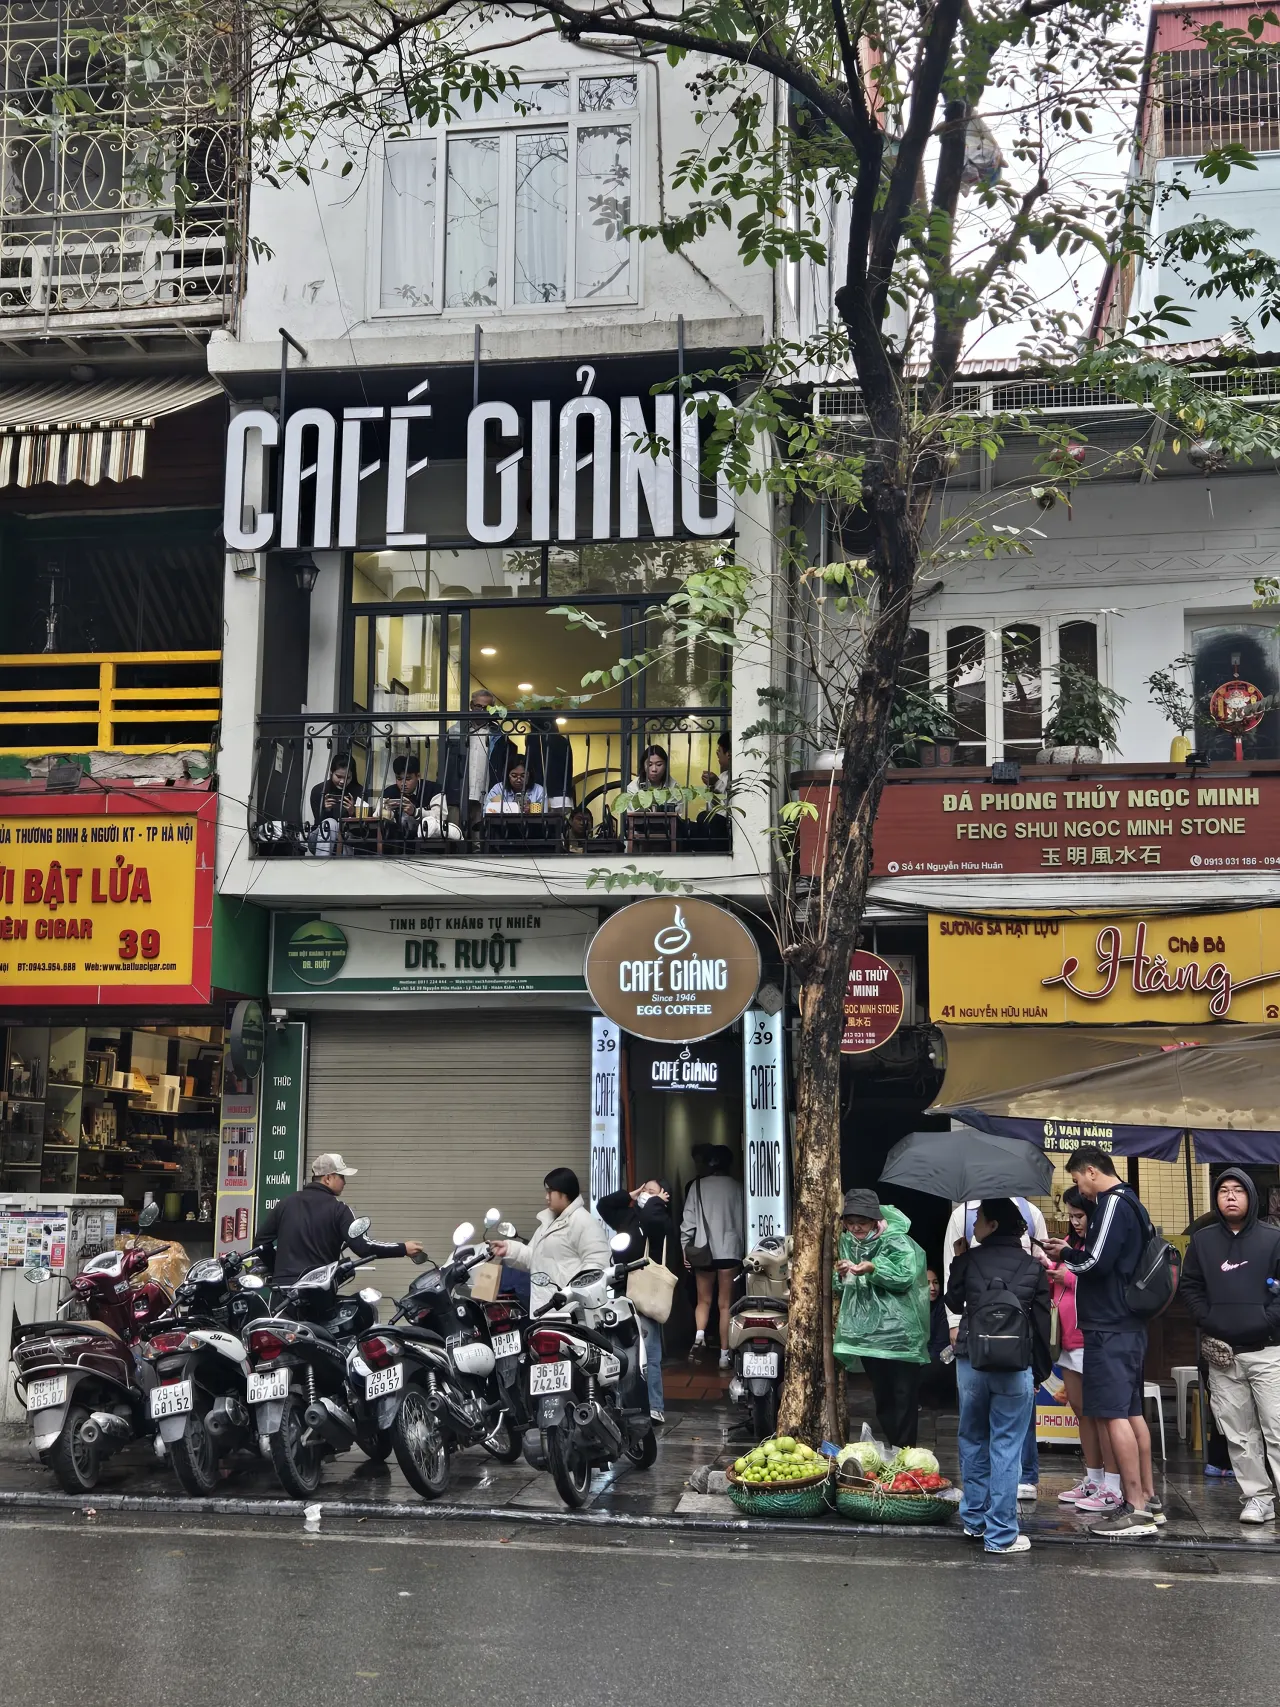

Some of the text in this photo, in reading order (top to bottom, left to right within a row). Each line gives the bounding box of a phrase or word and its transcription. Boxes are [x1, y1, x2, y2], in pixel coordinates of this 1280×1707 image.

[223, 379, 432, 552] CAFÉ
[942, 784, 1260, 812] ĐÁ PHONG THỦY NGỌC MINH
[16, 826, 52, 844] THƯƠNG
[56, 827, 78, 844] BINH
[81, 828, 88, 843] &
[91, 823, 119, 843] NGƯỜI
[123, 826, 135, 842] KT
[147, 826, 158, 842] TP
[162, 823, 174, 842] HÀ
[178, 822, 193, 845] NỘI
[956, 817, 1246, 840] FENG SHUI NGOC MINH STONE
[1041, 845, 1161, 866] 玉明風水石
[1204, 857, 1223, 866] 0913
[1225, 857, 1239, 865] 031
[1242, 857, 1257, 865] 186
[915, 862, 924, 870] 41
[926, 860, 959, 872] Nguyễn
[961, 861, 979, 870] Hữu
[981, 861, 1003, 870] Huân
[24, 860, 83, 911] BẬT
[92, 855, 152, 904] LỬA
[35, 918, 93, 940] CIGAR
[390, 914, 541, 932] TINH BỘT KHÁNG TỰ NHIÊN
[940, 920, 1059, 939] SƯƠNG SA HẠT LỰU
[119, 929, 161, 960] 39
[405, 933, 522, 974] DR. RUỘT
[1168, 936, 1226, 954] Chè Bà
[314, 959, 330, 971] RUỘT
[619, 953, 728, 992] CAFÉ GIẢNG
[864, 965, 889, 982] THỦY
[1042, 921, 1236, 1016] Hằng
[652, 993, 696, 1002] Since 1946
[853, 984, 879, 997] MINH
[636, 1004, 712, 1016] EGG COFFEE
[860, 1004, 876, 1014] MINH
[877, 1004, 900, 1014] STONE
[941, 1003, 1048, 1018] 41 NGUYỄN HỮU HUÂN
[596, 1038, 616, 1052] 39
[753, 1031, 773, 1045] 39
[652, 1058, 717, 1083] CAFÉ GIẢNG
[595, 1066, 616, 1117] CAFÉ
[750, 1058, 776, 1110] CAFÉ
[272, 1125, 287, 1136] CHO
[1059, 1125, 1113, 1138] VẠN NĂNG
[1059, 1138, 1079, 1150] 0839
[273, 1150, 285, 1161] LỢI
[758, 1214, 774, 1238] EGG
[371, 1366, 397, 1385] 29-D1
[536, 1363, 565, 1379] 36-B2
[745, 1365, 775, 1376] 620.98
[157, 1384, 185, 1401] 29-C1
[251, 1384, 285, 1401] 067.06
[368, 1377, 400, 1398] 969.57
[533, 1376, 568, 1393] 742.94
[154, 1397, 190, 1416] 681.52
